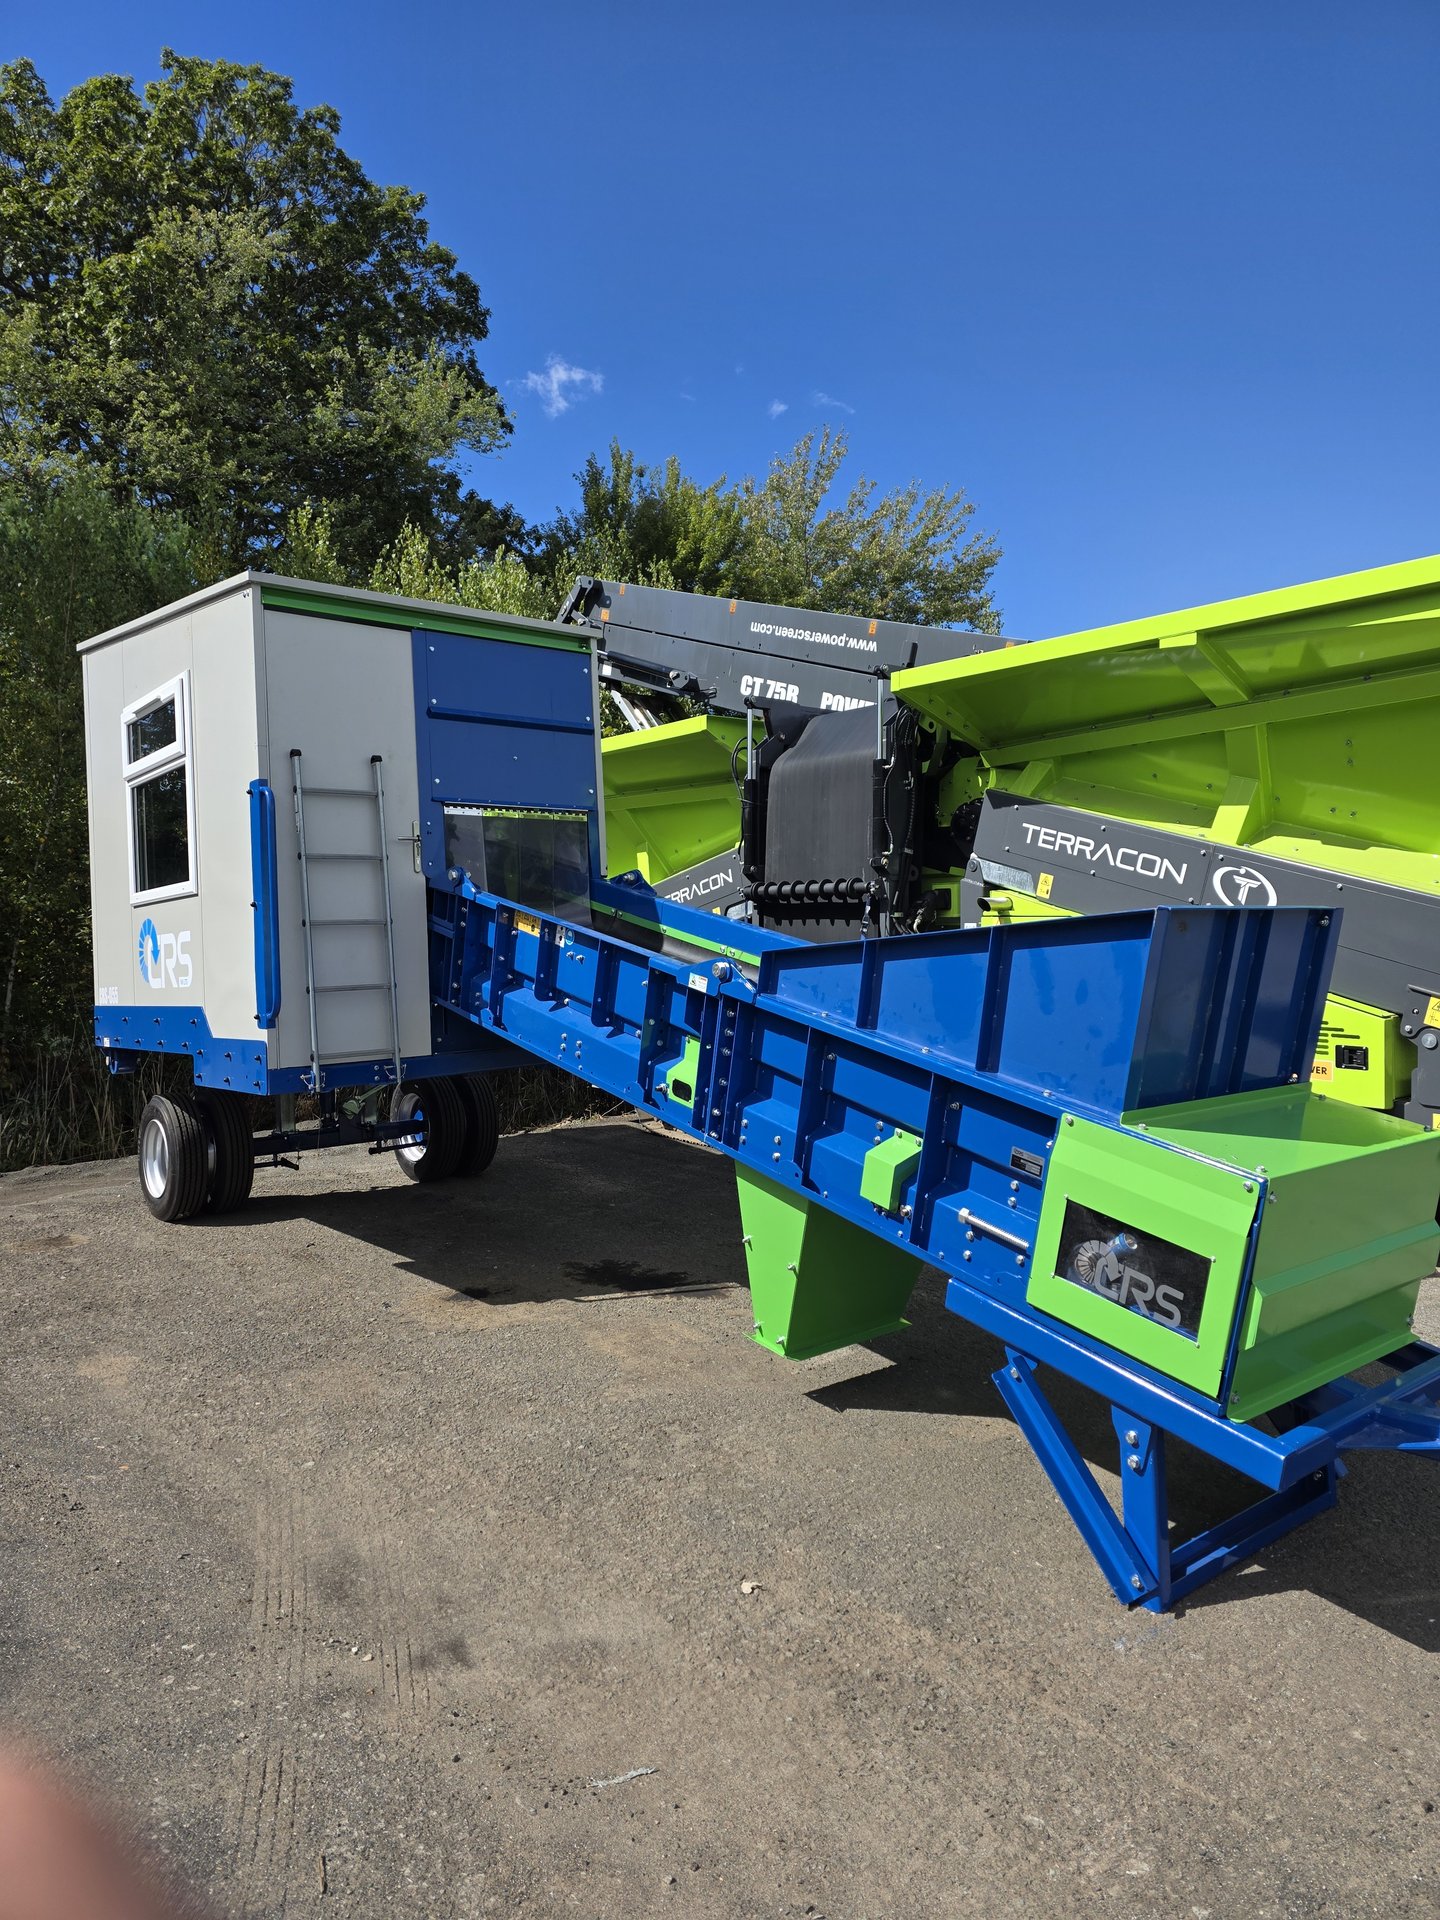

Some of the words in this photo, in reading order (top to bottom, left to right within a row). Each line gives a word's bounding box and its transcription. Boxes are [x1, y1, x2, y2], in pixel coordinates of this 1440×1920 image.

[750, 621, 877, 652] www.powerscreen.com
[740, 674, 764, 697] CT
[765, 679, 800, 704] 75R
[1022, 823, 1188, 885] TERRACON
[664, 868, 733, 904] RRACON
[1092, 1252, 1185, 1328] CRS
